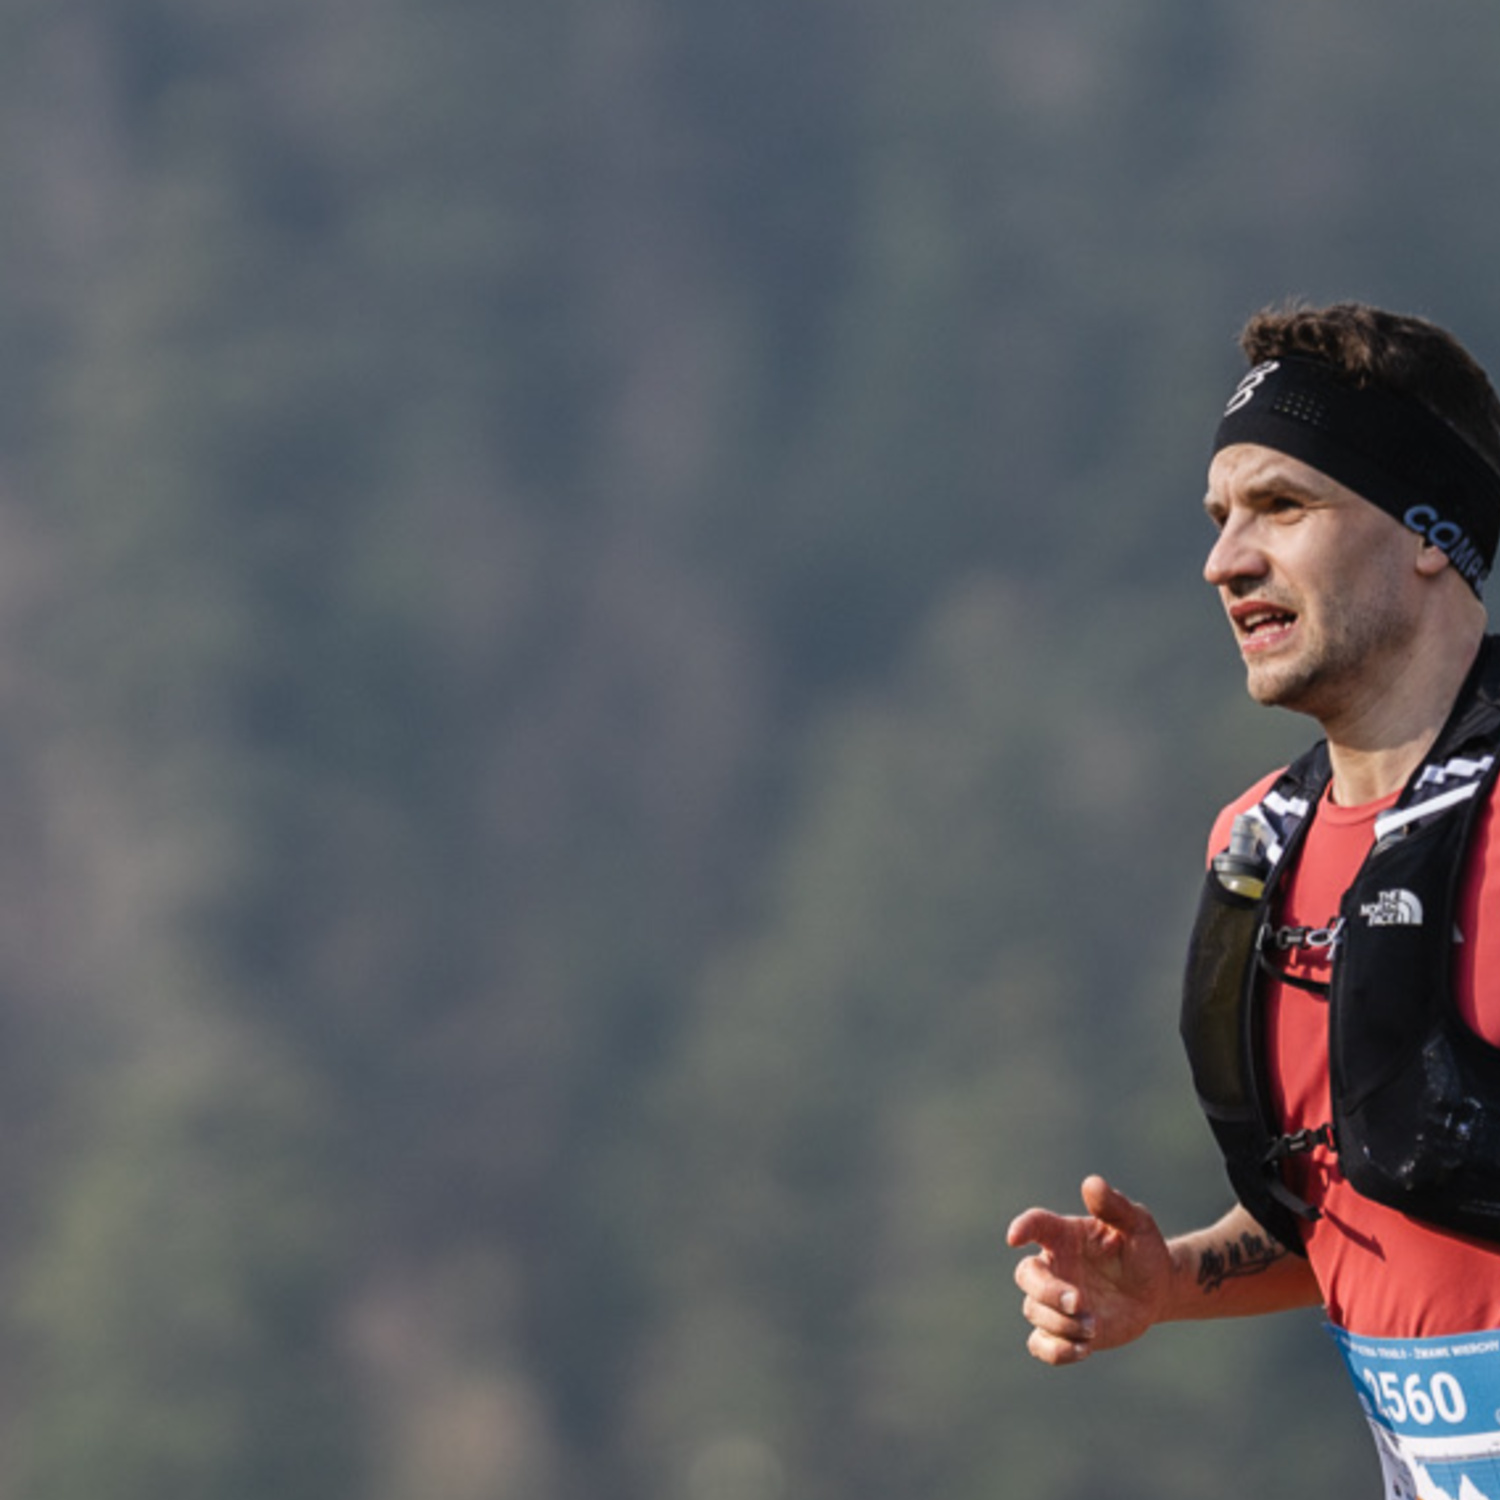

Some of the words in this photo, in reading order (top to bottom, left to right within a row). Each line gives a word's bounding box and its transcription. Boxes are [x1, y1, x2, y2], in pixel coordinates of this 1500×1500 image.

[1379, 890, 1400, 902] THE
[1360, 901, 1398, 916] NORTH
[1368, 913, 1397, 927] FACE
